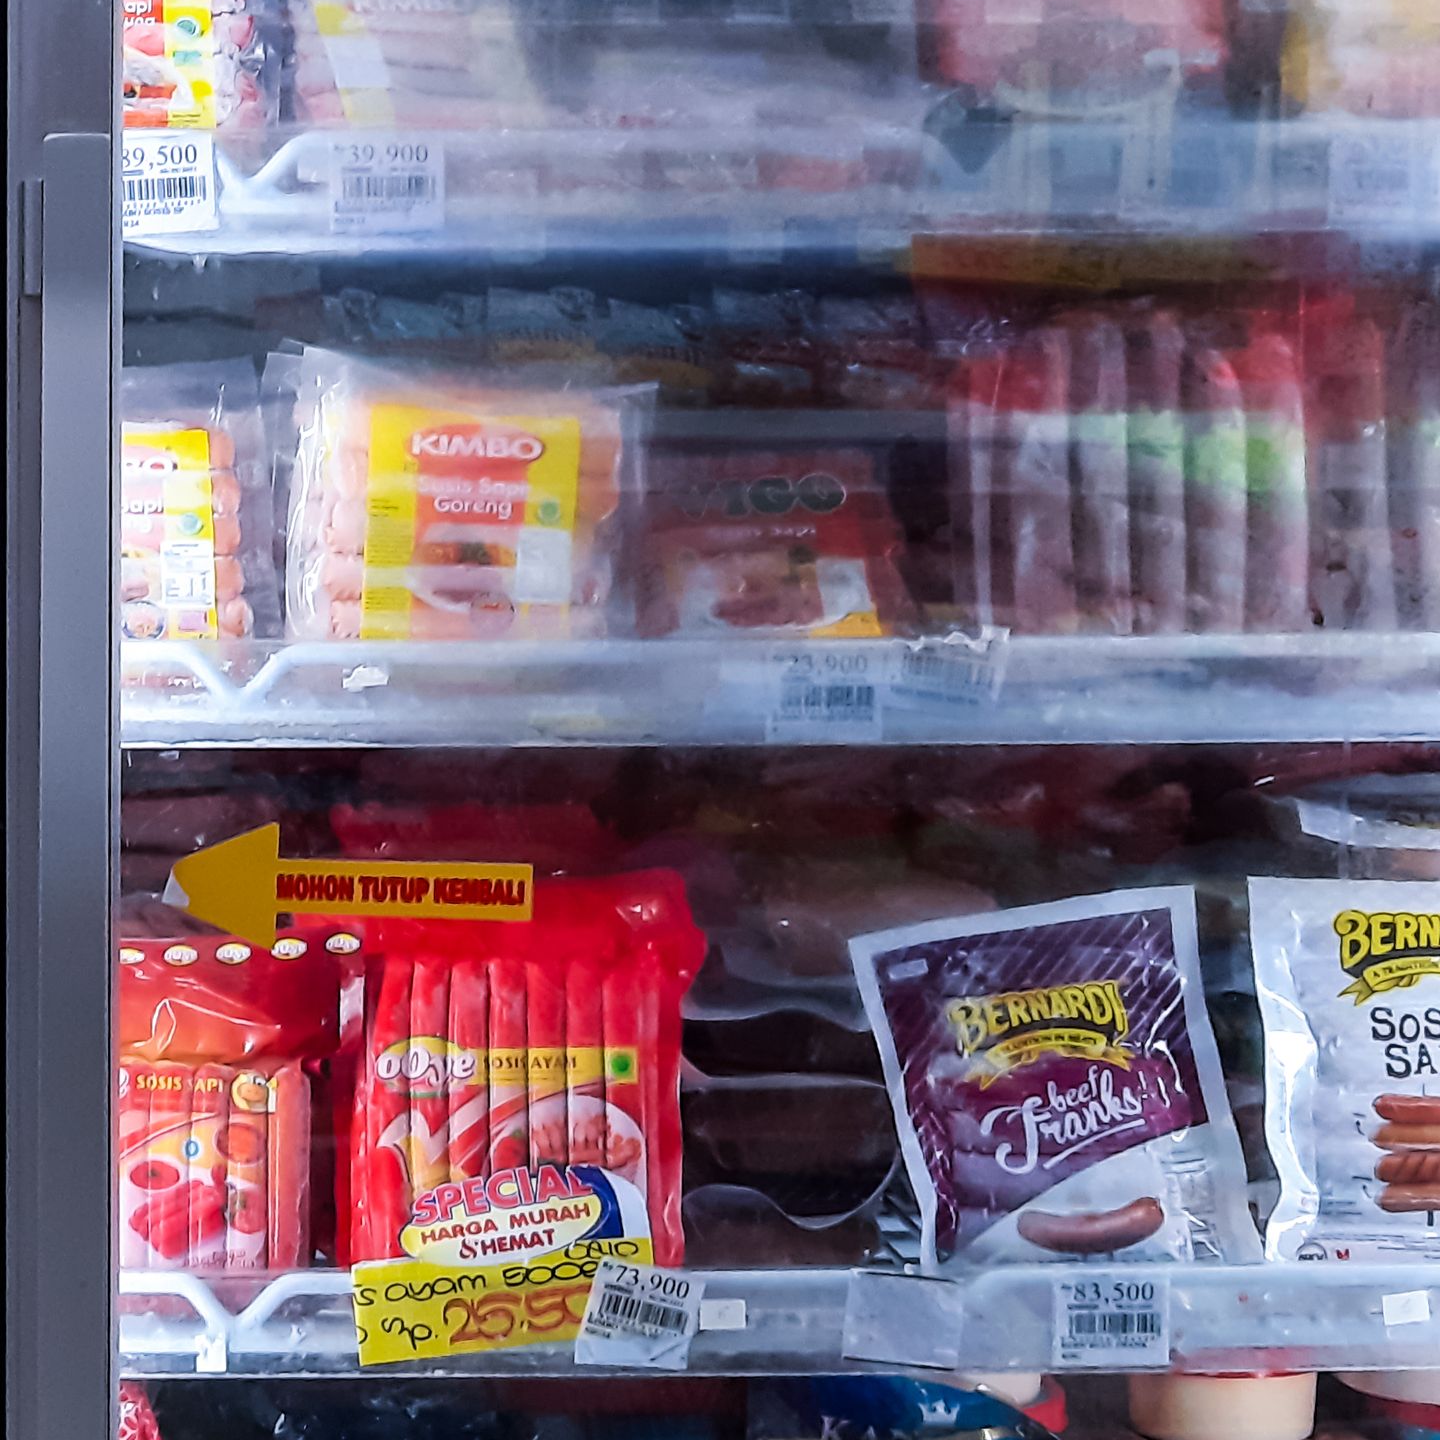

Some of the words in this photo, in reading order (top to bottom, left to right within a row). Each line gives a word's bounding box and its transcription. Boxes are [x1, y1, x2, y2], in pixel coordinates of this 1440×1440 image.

[411, 433, 544, 459] KIMBO
[432, 496, 514, 521] Goreng
[276, 872, 355, 903] MOHON
[359, 874, 431, 904] TUTUP
[433, 874, 527, 907] KEMBALI
[950, 981, 1126, 1048] BERNARDI
[135, 1074, 183, 1093] SOSIS
[1047, 1064, 1102, 1113] beef
[411, 1163, 595, 1227] SPECIAL
[421, 1219, 499, 1246] HARGA
[508, 1202, 591, 1231] MURAH
[480, 1228, 556, 1258] HEMAT
[616, 1264, 691, 1300] 73,900
[1072, 1282, 1154, 1304] 83,500
